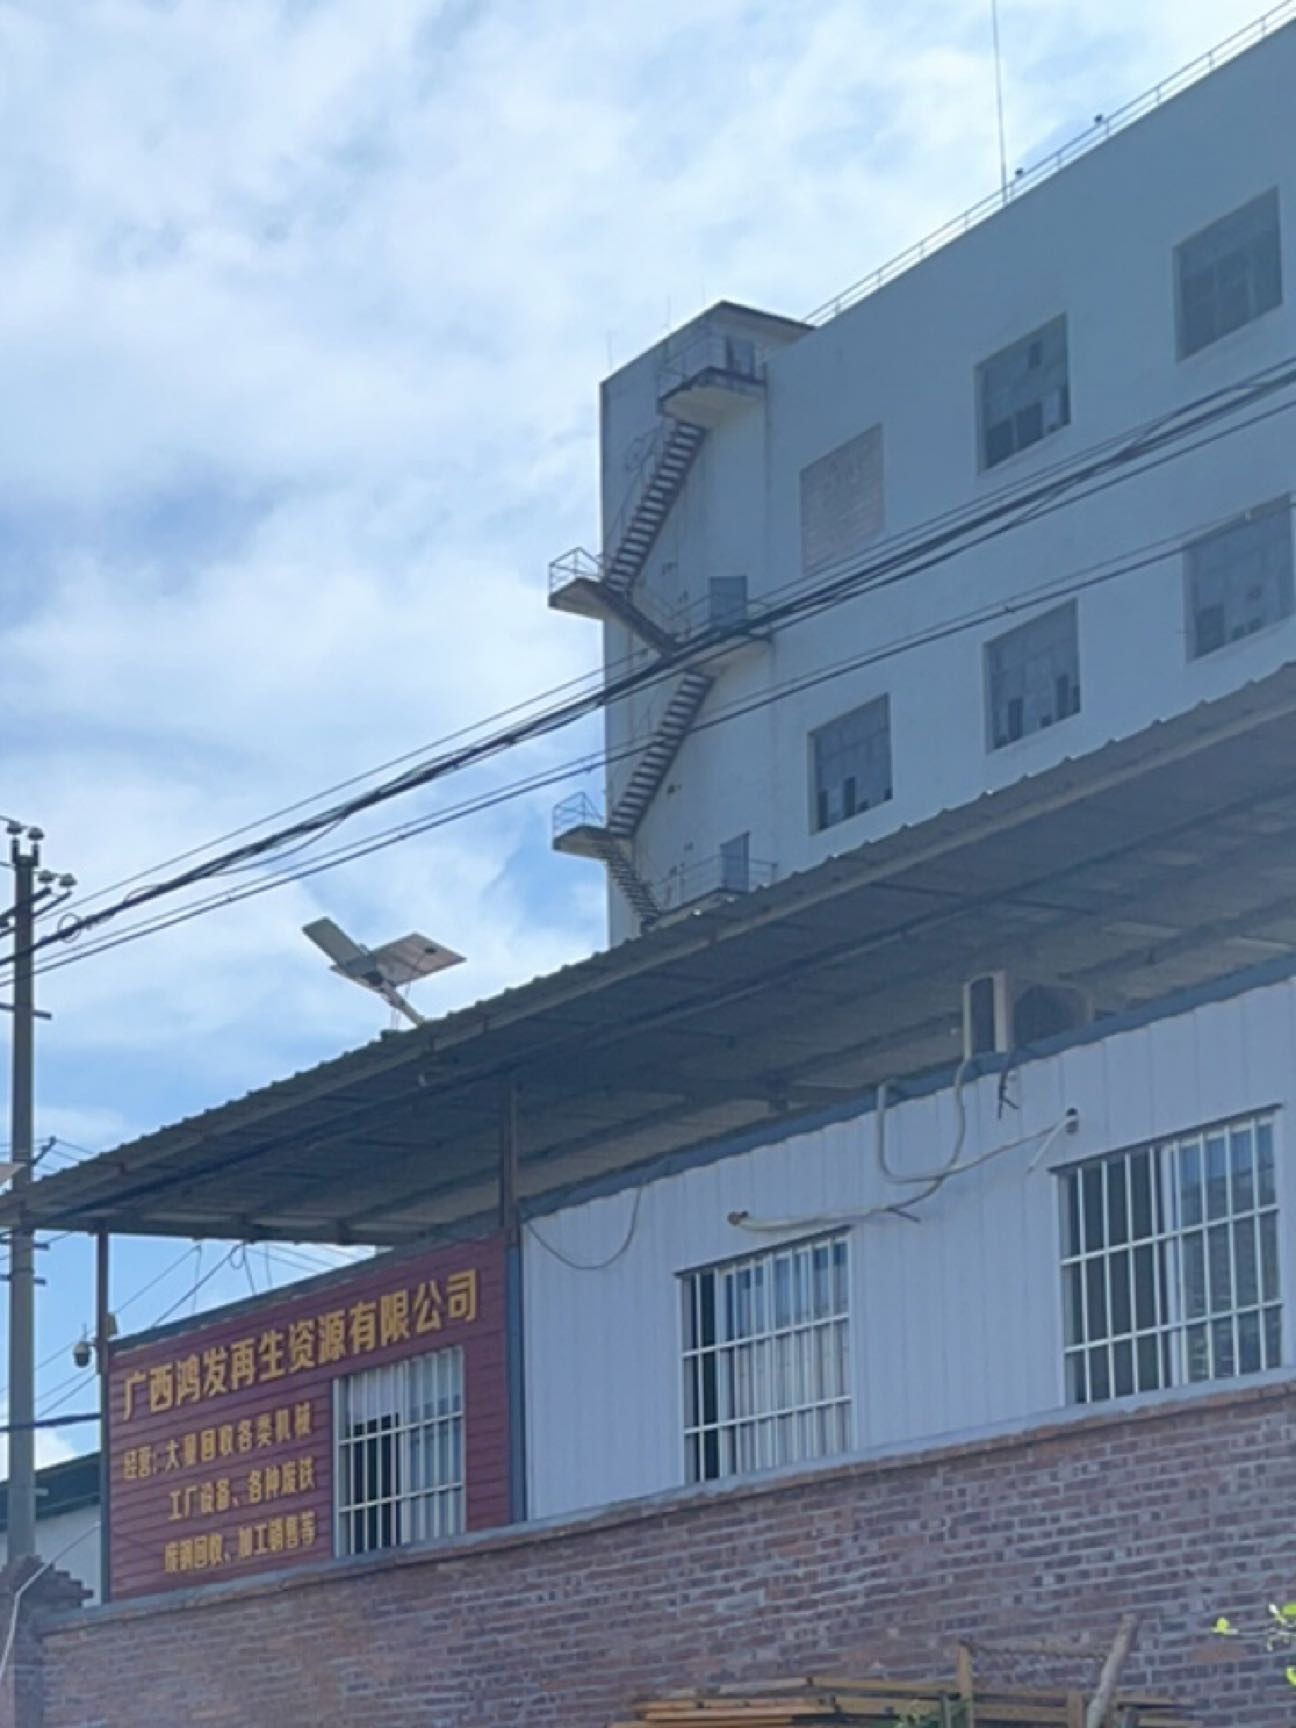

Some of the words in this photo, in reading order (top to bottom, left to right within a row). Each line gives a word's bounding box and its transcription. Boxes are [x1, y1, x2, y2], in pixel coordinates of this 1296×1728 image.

[123, 1269, 477, 1421] 广西鸿发再生资源有限公司
